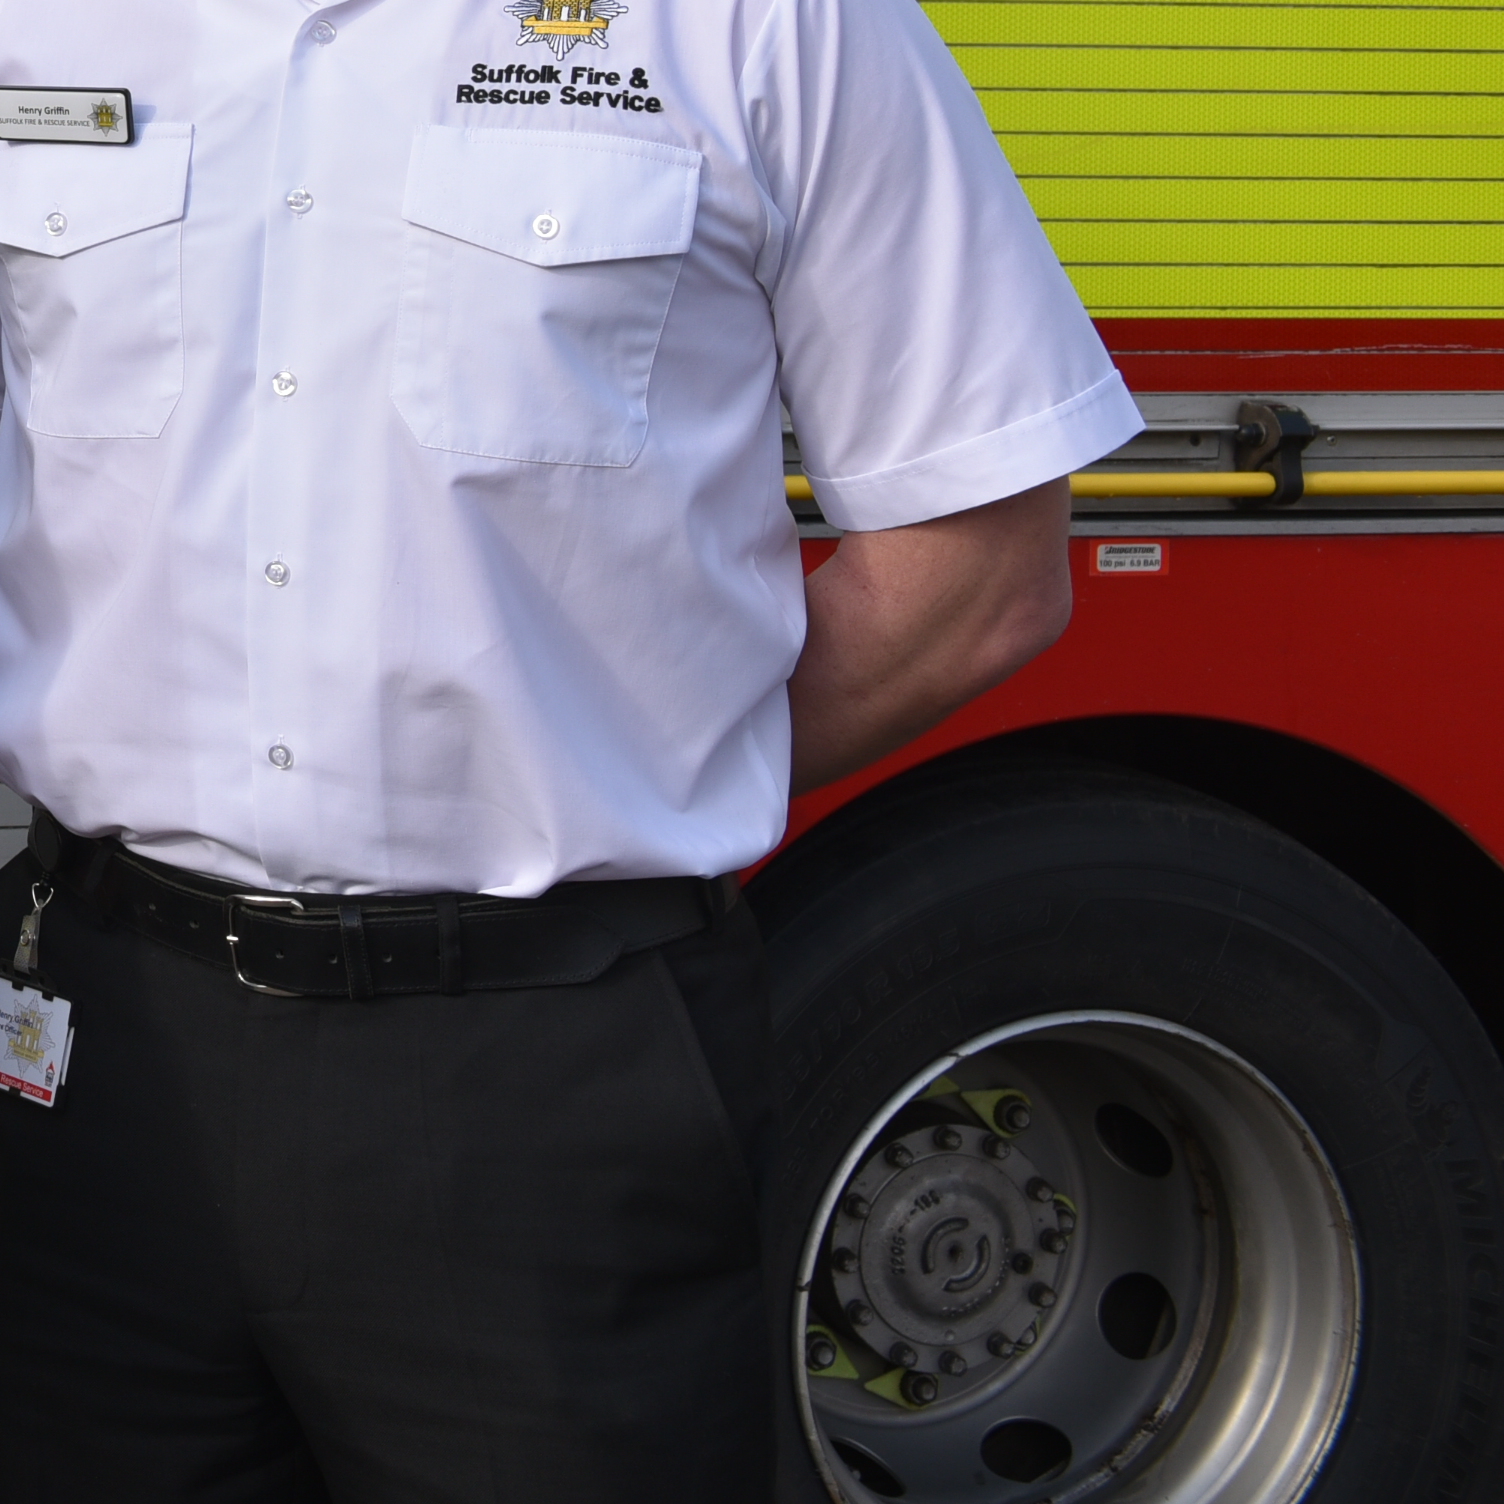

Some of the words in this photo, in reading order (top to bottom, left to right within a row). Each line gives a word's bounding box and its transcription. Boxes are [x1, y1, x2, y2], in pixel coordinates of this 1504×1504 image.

[471, 63, 561, 84] Suffolk
[571, 66, 621, 86] Fire
[629, 67, 649, 90] &
[456, 84, 551, 104] Rescue
[560, 86, 662, 113] Service
[18, 106, 42, 116] Henry
[44, 106, 70, 115] Griffin
[1099, 559, 1112, 567] 100
[1114, 560, 1126, 568] psi
[1130, 559, 1141, 567] 6.9
[1143, 559, 1160, 567] BAR
[14, 1015, 34, 1028] Griffin
[1, 1074, 22, 1090] Rescue
[23, 1081, 44, 1097] Service
